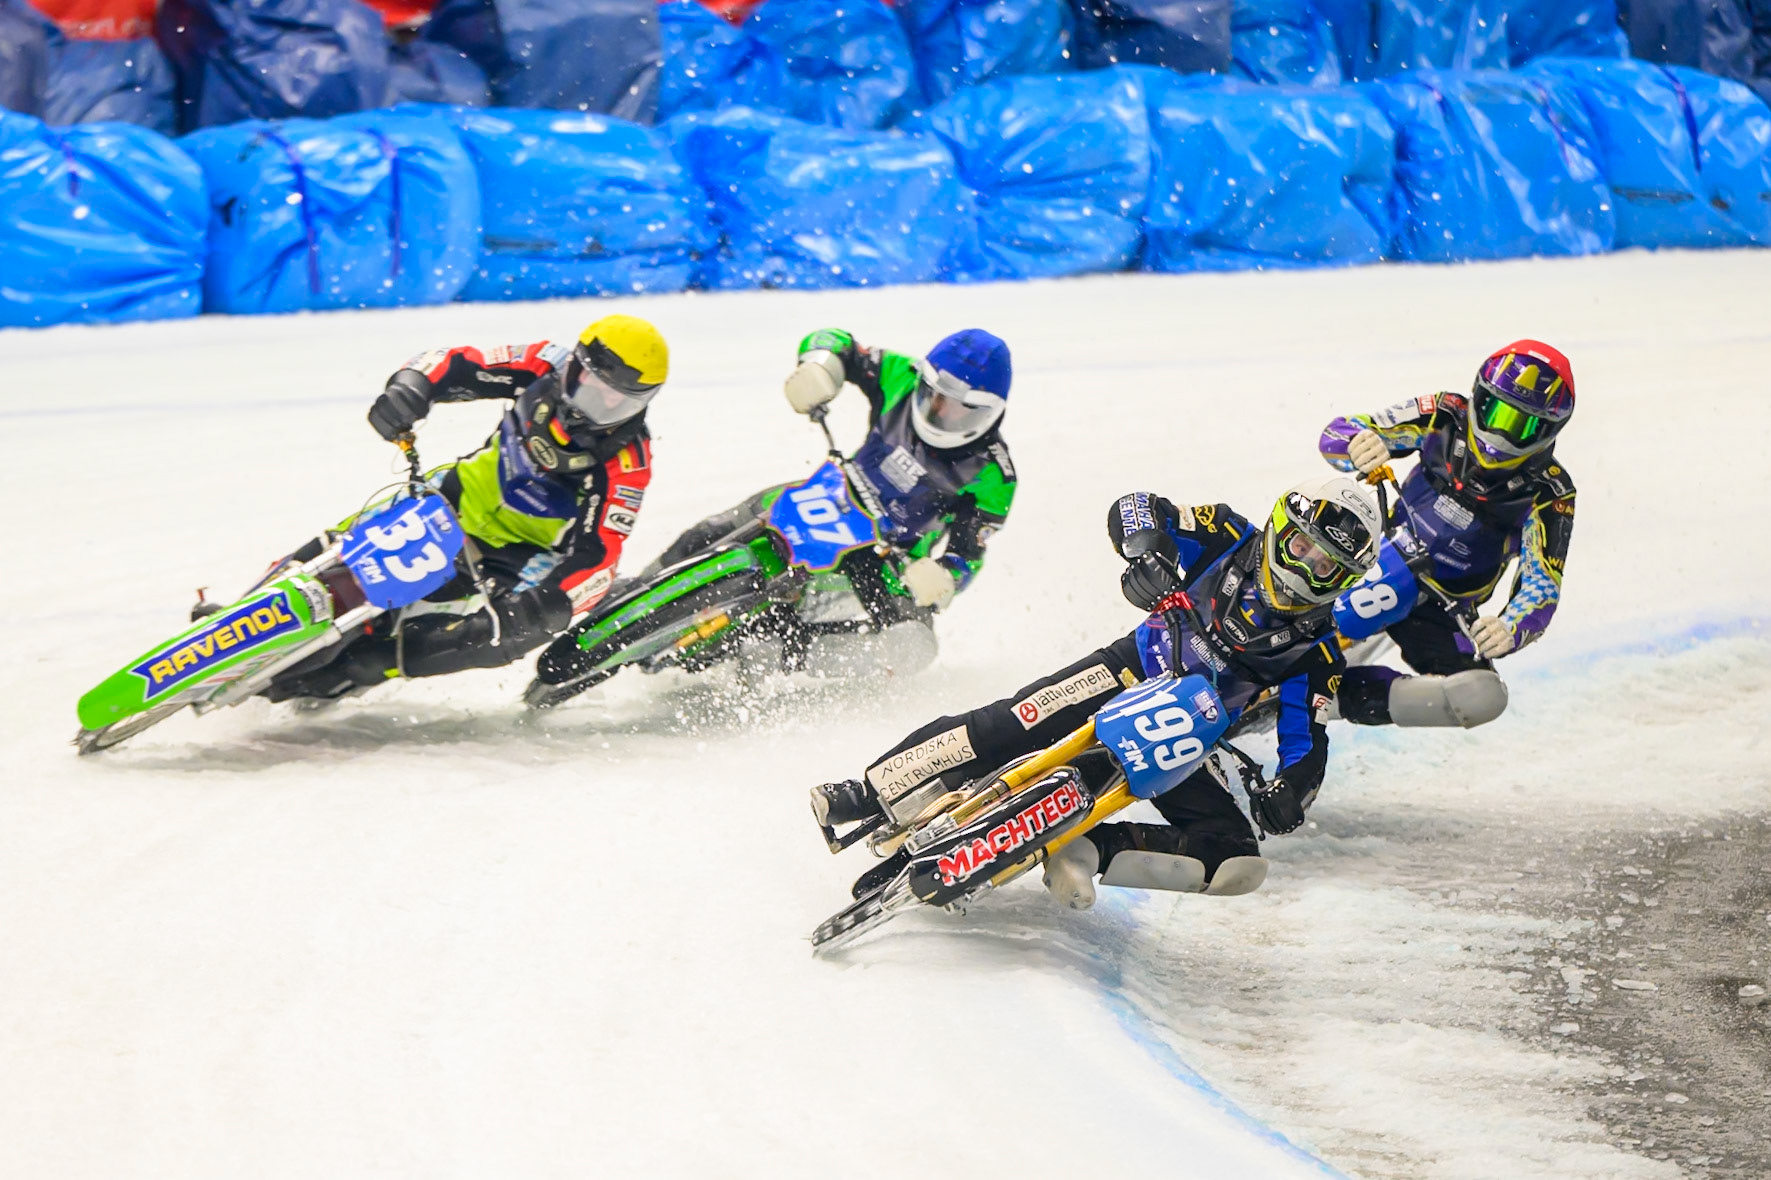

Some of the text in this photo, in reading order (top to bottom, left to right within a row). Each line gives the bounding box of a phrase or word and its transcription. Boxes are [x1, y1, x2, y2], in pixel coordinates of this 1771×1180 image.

[789, 484, 858, 546] 107
[1119, 494, 1139, 538] CENTE
[1134, 491, 1155, 531] MAHA
[360, 556, 387, 584] FIM
[364, 510, 448, 583] 33
[148, 603, 293, 685] RAVENOL
[881, 732, 957, 779] NORDISKA
[1117, 736, 1149, 772] FIM
[1119, 690, 1204, 771] 199
[880, 745, 973, 800] CENTRUMHUS
[937, 780, 1084, 887] MACHTECH
